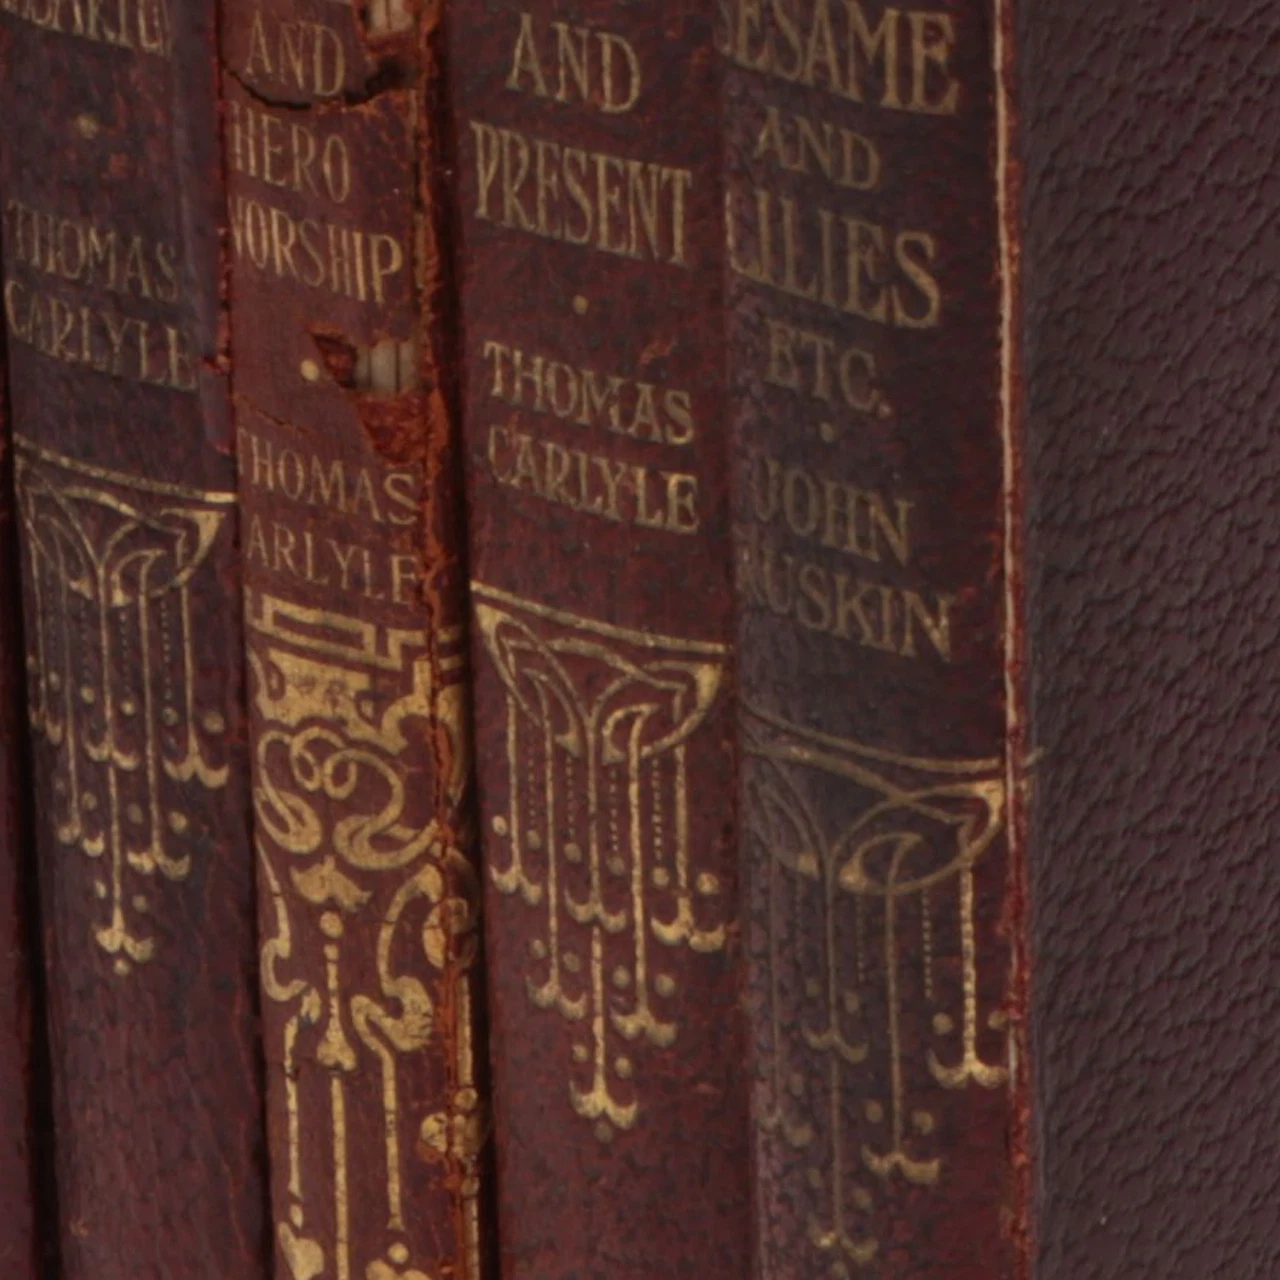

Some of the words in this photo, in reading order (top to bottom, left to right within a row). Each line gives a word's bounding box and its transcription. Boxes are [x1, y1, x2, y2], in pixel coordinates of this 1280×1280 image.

[243, 9, 347, 98] AND
[504, 12, 642, 114] AND
[230, 100, 353, 205] HERO
[469, 121, 693, 268] PRESENT
[753, 105, 883, 192] AND
[6, 198, 181, 304] THOMAS
[4, 278, 200, 392] CARLYLE
[765, 317, 894, 421] ETC.
[483, 341, 695, 446] THOMAS
[487, 424, 701, 535] CARLYLE
[246, 512, 422, 604] ARLYLE
